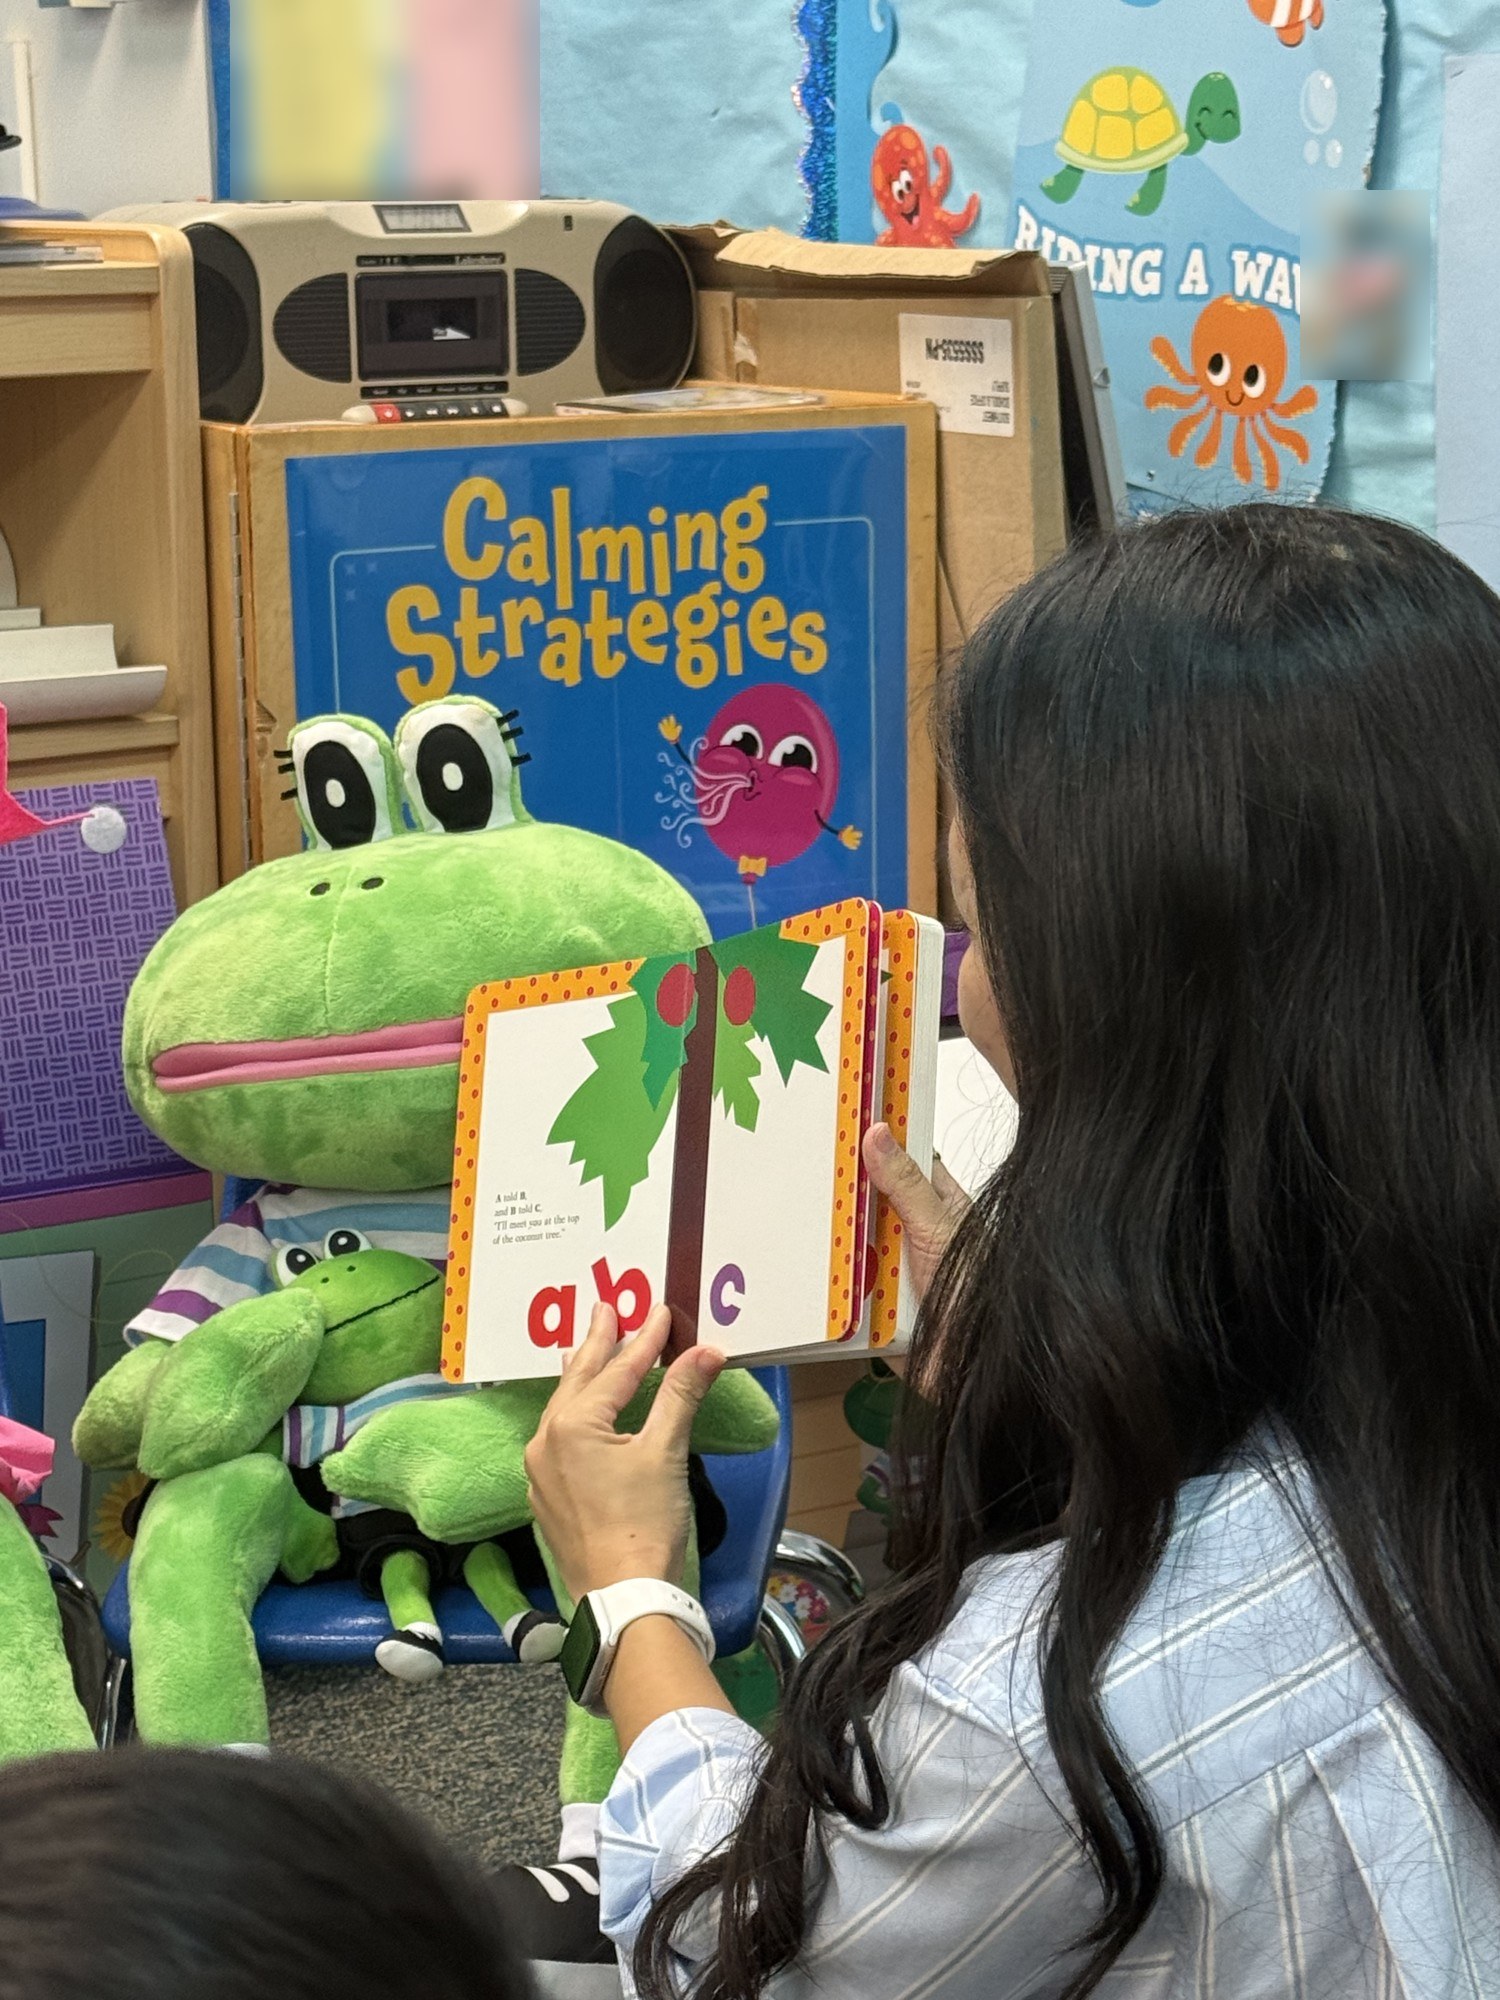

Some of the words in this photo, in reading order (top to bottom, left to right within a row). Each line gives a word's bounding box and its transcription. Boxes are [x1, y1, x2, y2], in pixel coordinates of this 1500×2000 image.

[1178, 249, 1209, 295] A
[443, 476, 770, 610] Calming
[386, 581, 829, 706] Strategies
[494, 1206, 508, 1216] and
[510, 1206, 516, 1215] B
[518, 1204, 533, 1214] told
[495, 1194, 501, 1203] A
[503, 1191, 518, 1202] told
[509, 1220, 527, 1229] meet
[528, 1219, 542, 1230] you
[544, 1217, 551, 1226] at
[554, 1214, 566, 1225] the
[568, 1215, 580, 1225] top
[492, 1234, 500, 1245] of
[502, 1234, 513, 1244] the
[515, 1232, 543, 1243] coconut
[527, 1284, 576, 1349] a
[591, 1256, 652, 1343] b
[709, 1263, 746, 1327] c
